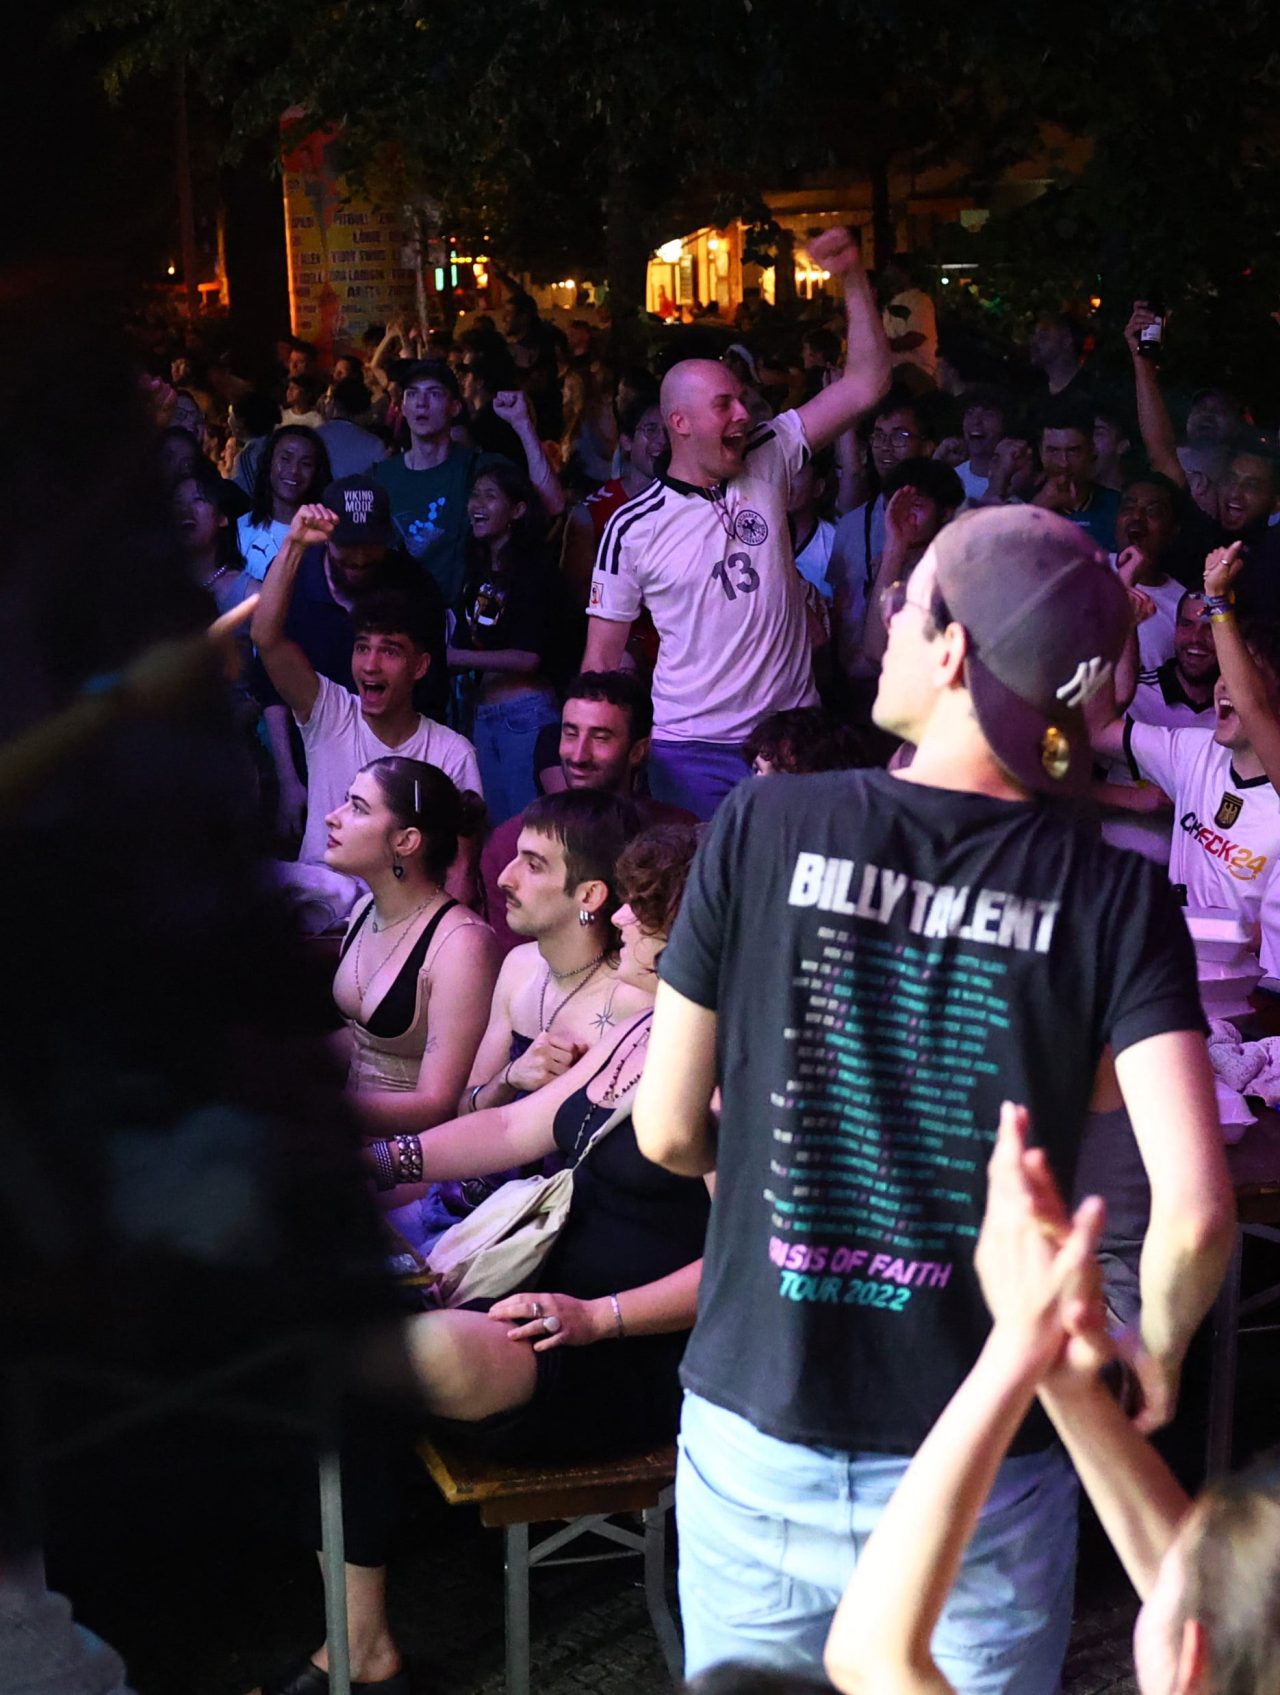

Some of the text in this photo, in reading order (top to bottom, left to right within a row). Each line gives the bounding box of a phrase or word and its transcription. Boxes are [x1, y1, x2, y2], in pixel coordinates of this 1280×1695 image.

[344, 490, 374, 502] VIKING
[345, 500, 374, 513] MODE
[352, 511, 367, 524] ON
[711, 551, 760, 601] 13
[1180, 812, 1267, 873] CHECK24
[788, 851, 1061, 954] BILLY TALENT
[830, 1247, 869, 1273] OF
[867, 1253, 952, 1288] FAITH
[779, 1270, 912, 1312] TOUR 2022
